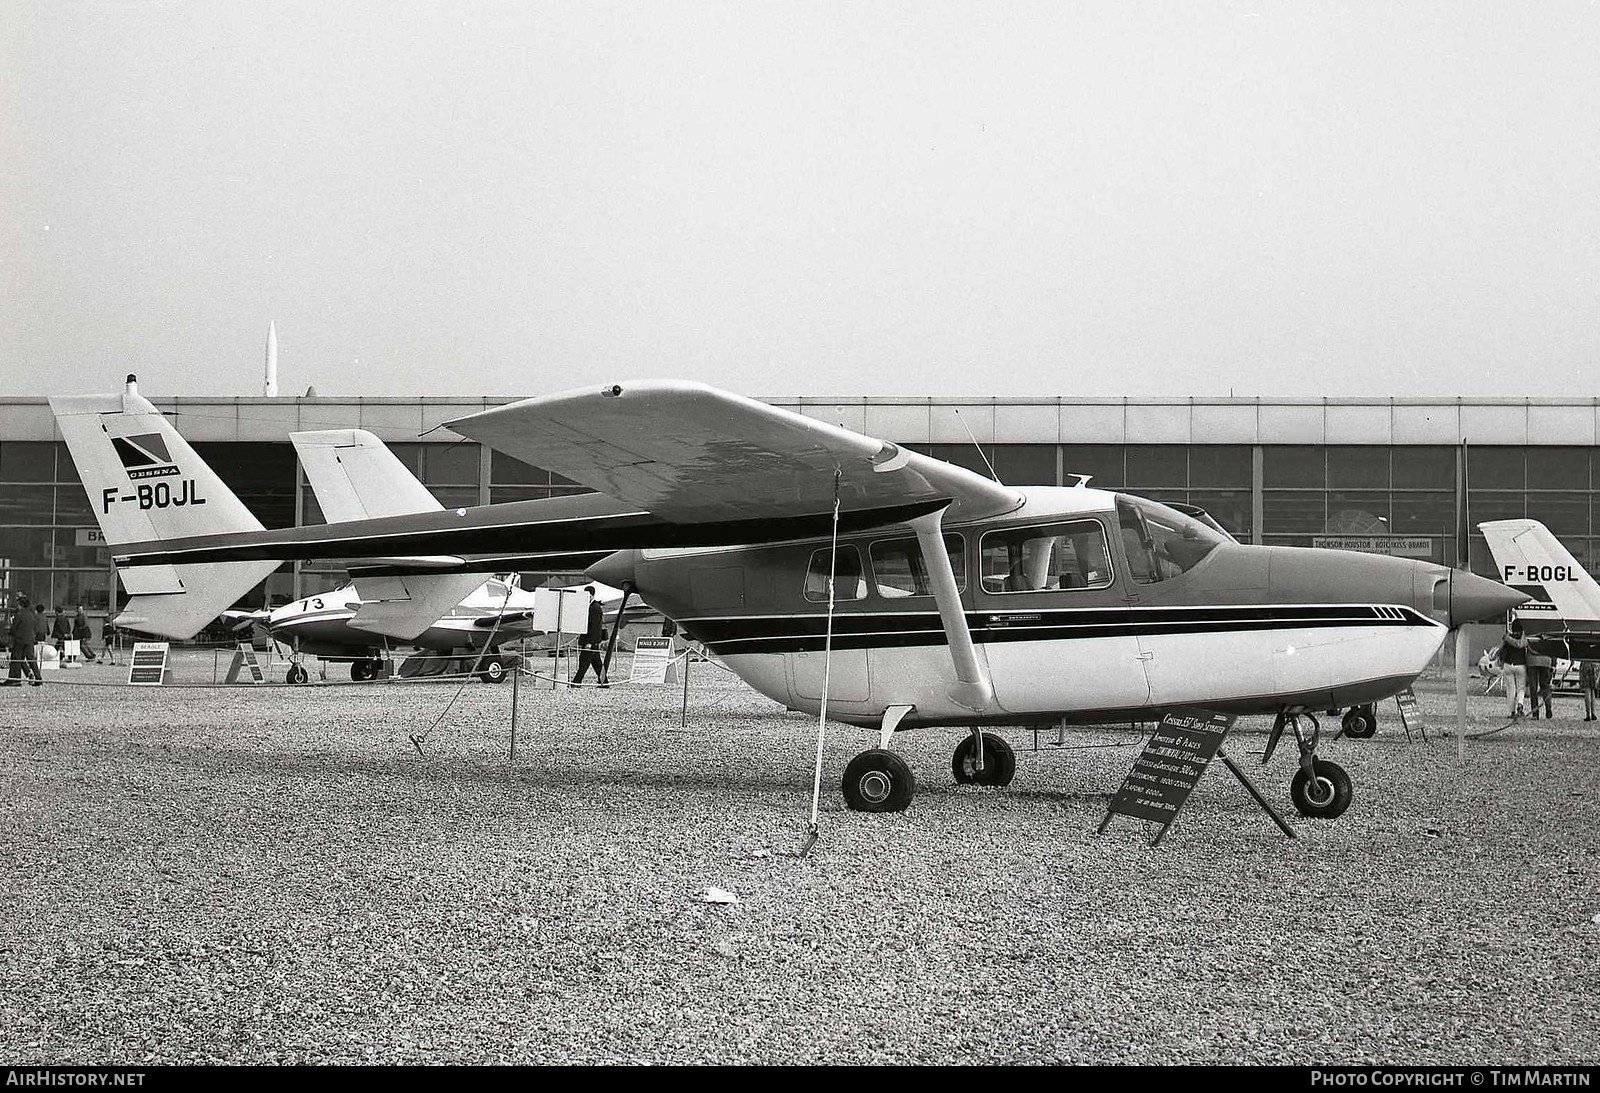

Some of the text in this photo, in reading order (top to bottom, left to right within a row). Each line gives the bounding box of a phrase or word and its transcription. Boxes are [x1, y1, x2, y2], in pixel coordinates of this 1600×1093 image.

[130, 468, 178, 478] CESSNA
[103, 480, 206, 514] F-BOJL
[1504, 565, 1579, 582] F-BOGL
[299, 598, 324, 612] 73
